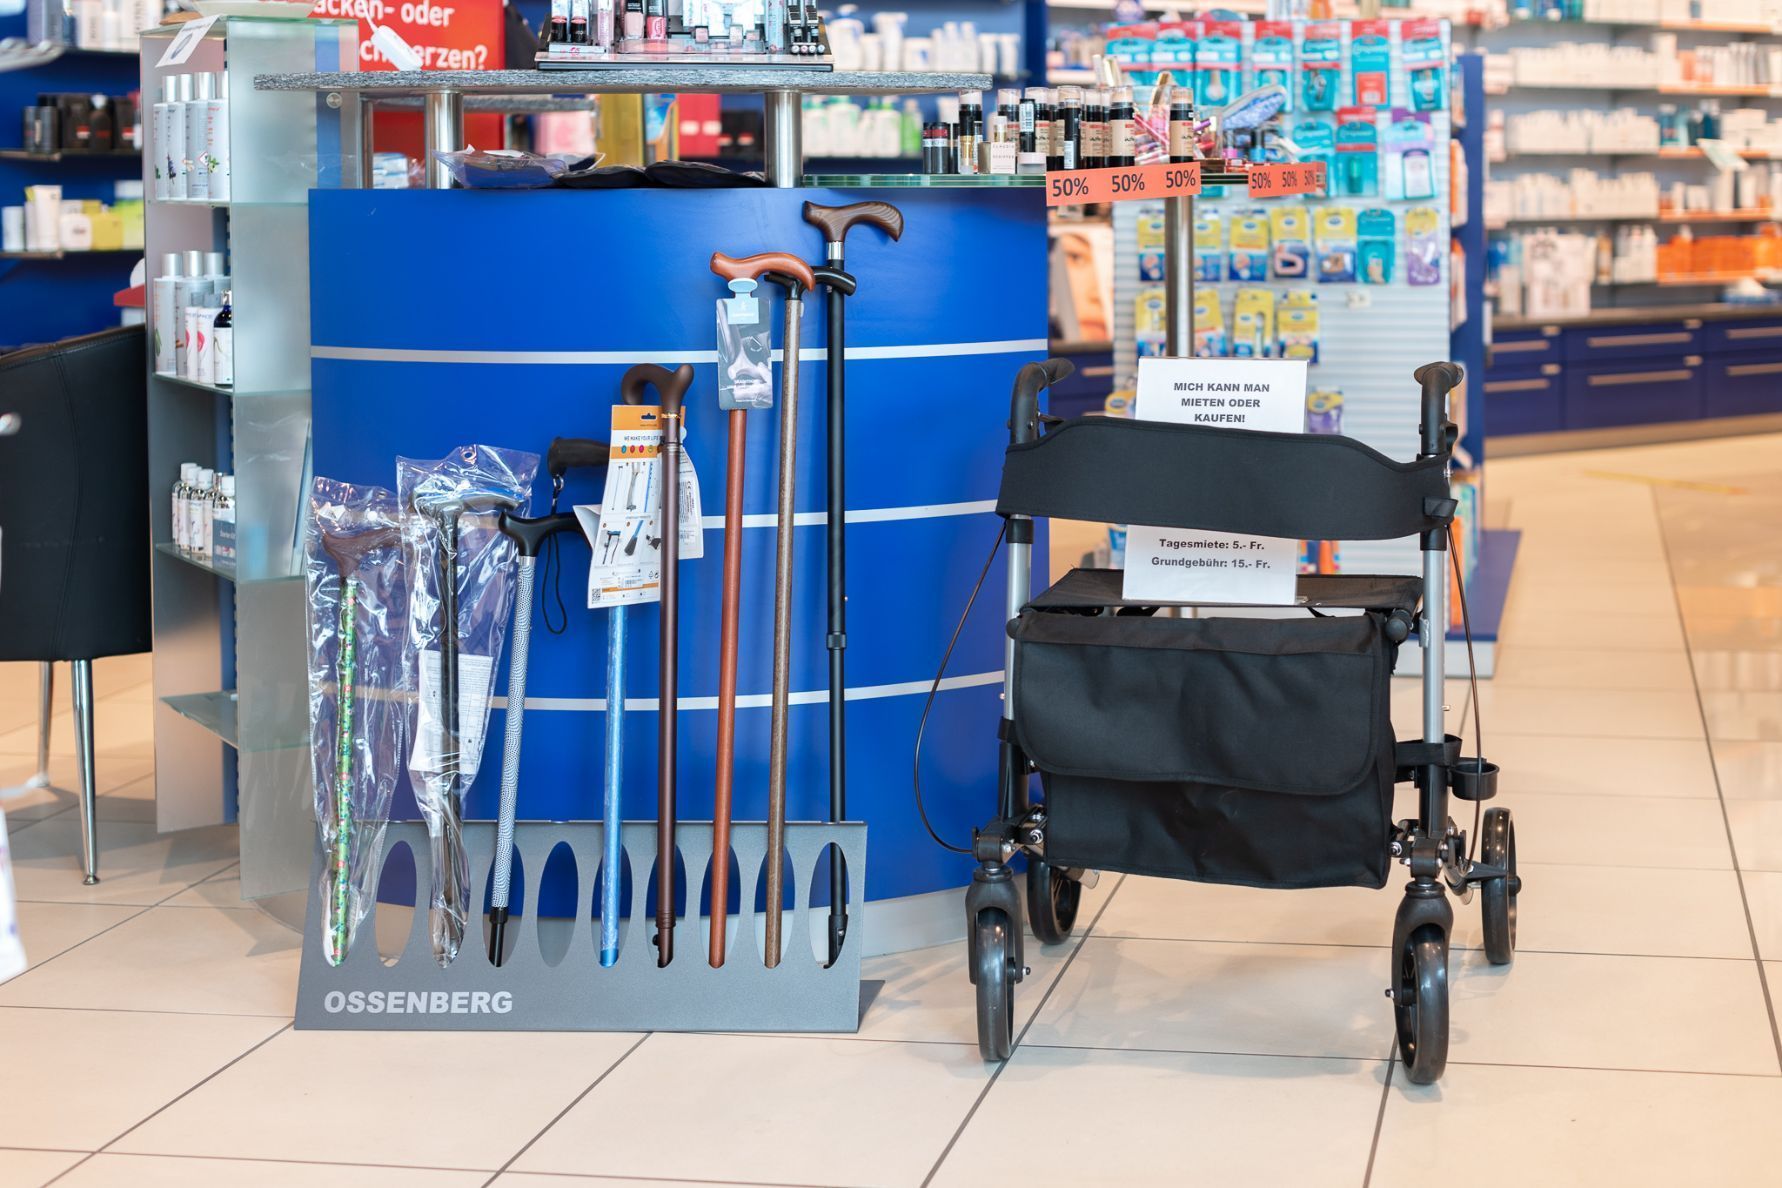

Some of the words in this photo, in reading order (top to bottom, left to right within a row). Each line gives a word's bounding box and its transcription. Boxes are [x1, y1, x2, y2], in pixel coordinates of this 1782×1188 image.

[313, 0, 395, 20] acken-
[400, 1, 455, 27] oder
[1052, 177, 1089, 197] 50%
[1111, 173, 1145, 193] 50%
[1165, 169, 1196, 188] 50%
[1251, 172, 1272, 190] 50%
[1282, 171, 1298, 188] 50%
[1304, 170, 1316, 187] 50%
[1173, 382, 1203, 391] MICH
[1207, 383, 1240, 392] KANN
[1243, 383, 1270, 392] MAN
[1181, 398, 1225, 407] MIETEN
[1228, 398, 1261, 408] ODER
[1194, 413, 1246, 423] KAUFEN!
[1159, 538, 1229, 549] Tagesmiete:
[1232, 540, 1247, 550] 5.-
[1250, 541, 1265, 550] Fr.
[1151, 556, 1228, 569] Grundgebühr:
[1231, 559, 1253, 569] 15.-
[1255, 560, 1271, 569] Fr.
[324, 990, 513, 1014] OSSENBERG
